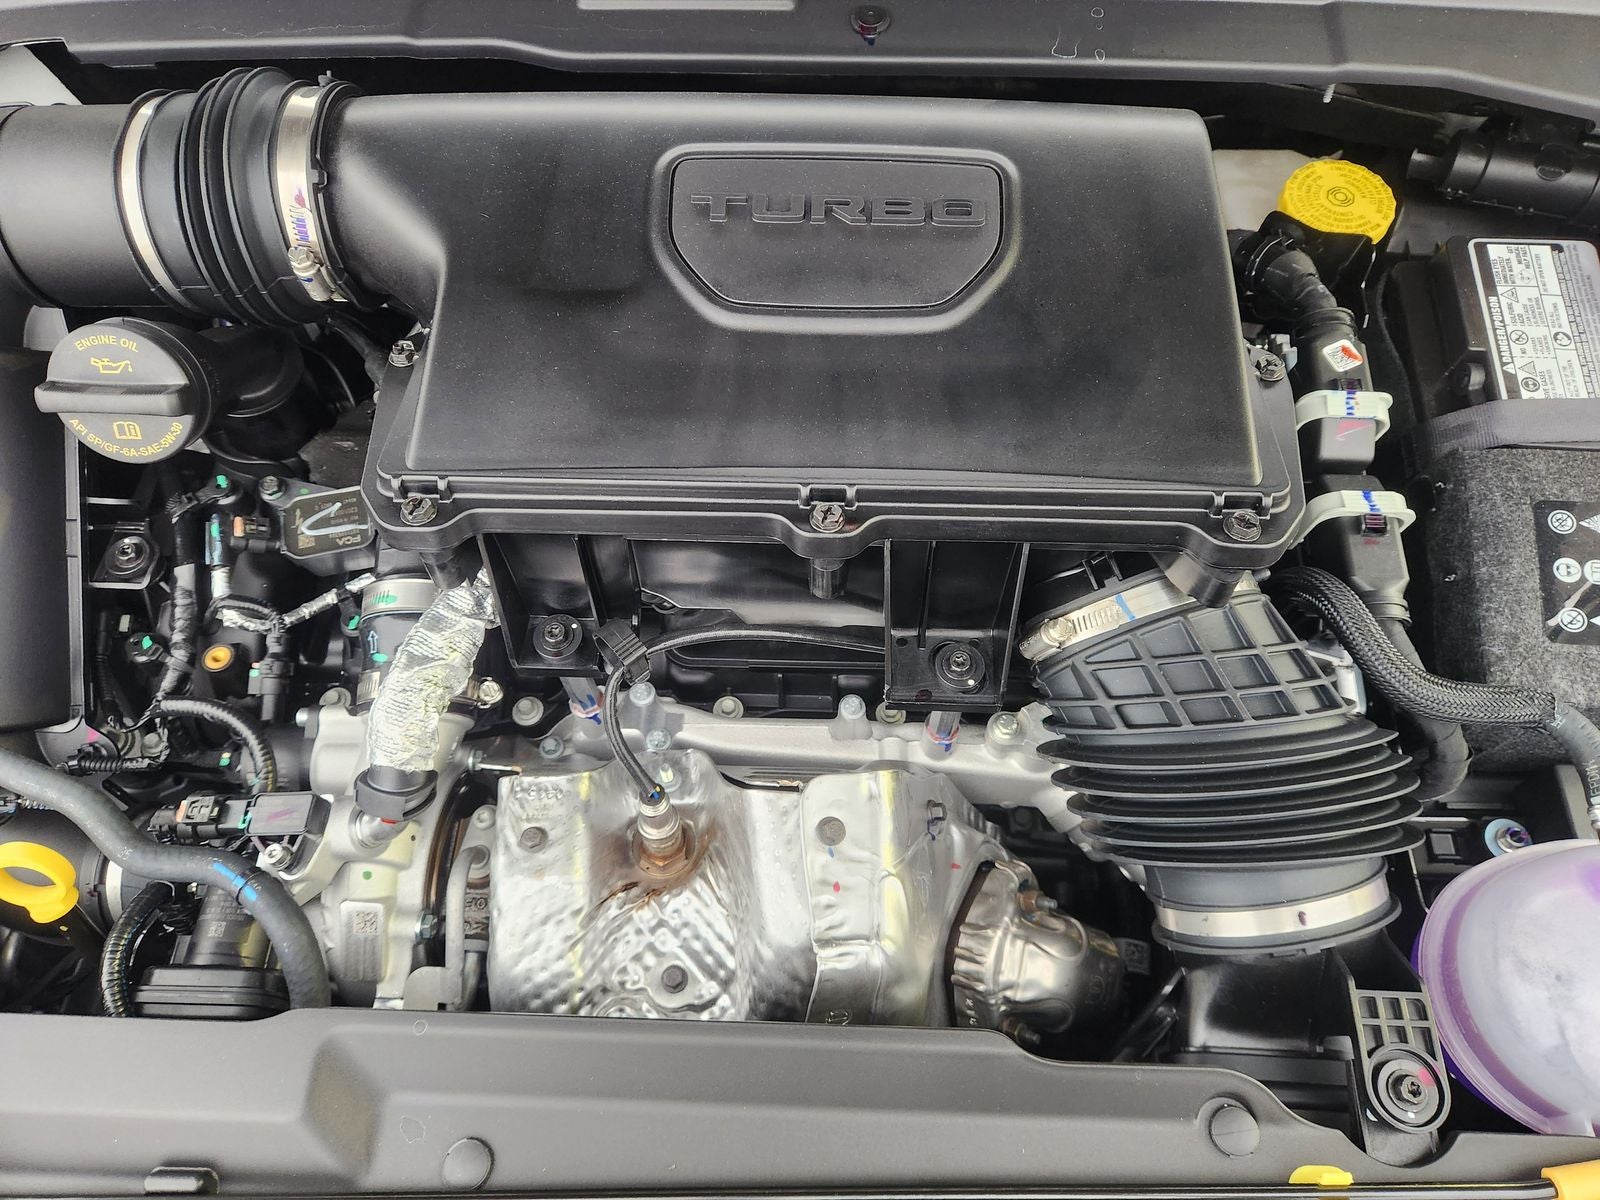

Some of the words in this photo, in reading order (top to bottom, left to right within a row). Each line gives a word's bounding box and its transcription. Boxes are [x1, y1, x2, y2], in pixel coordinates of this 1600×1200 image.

[690, 192, 987, 227] TURBO
[1487, 295, 1512, 362] DANGER/POISON
[75, 335, 117, 351] ENGINE
[120, 338, 139, 353] OIL
[69, 419, 88, 436] API
[336, 534, 362, 546] FCA
